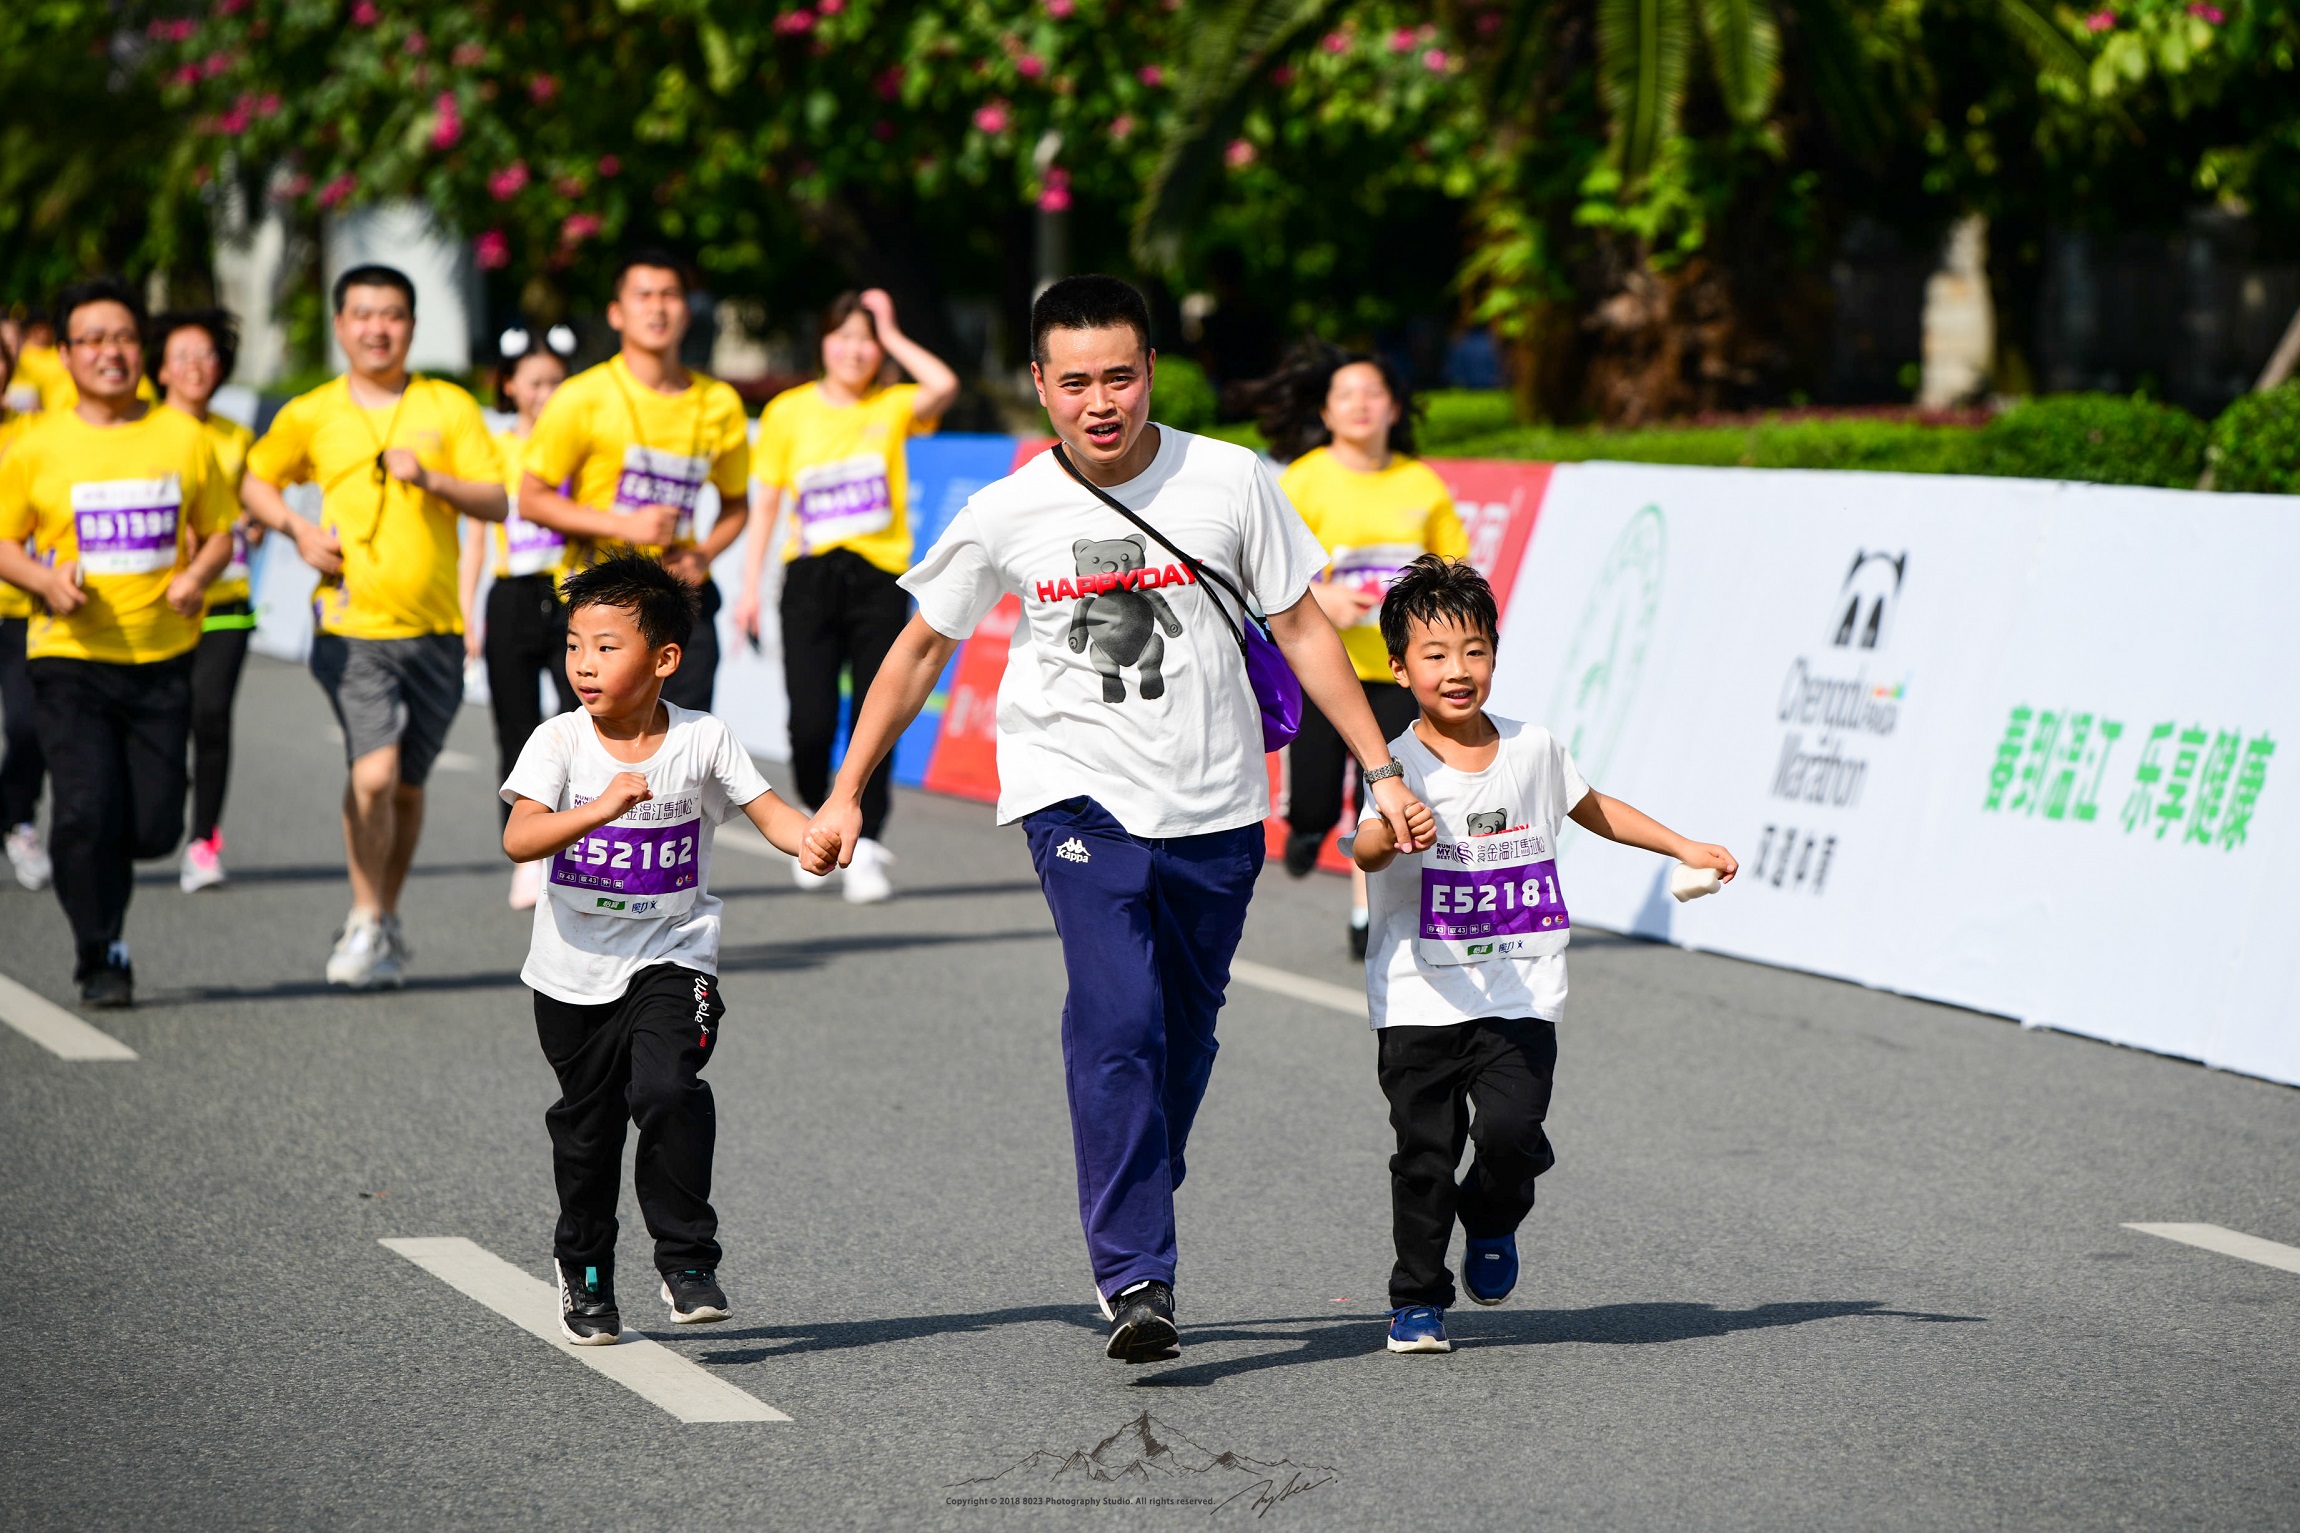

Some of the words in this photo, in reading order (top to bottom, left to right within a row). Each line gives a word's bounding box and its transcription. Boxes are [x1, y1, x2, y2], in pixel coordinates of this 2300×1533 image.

[2119, 721, 2276, 852] 乐享健康
[564, 835, 693, 870] E52162
[1056, 848, 1089, 863] Kappa
[1432, 875, 1558, 914] E52181
